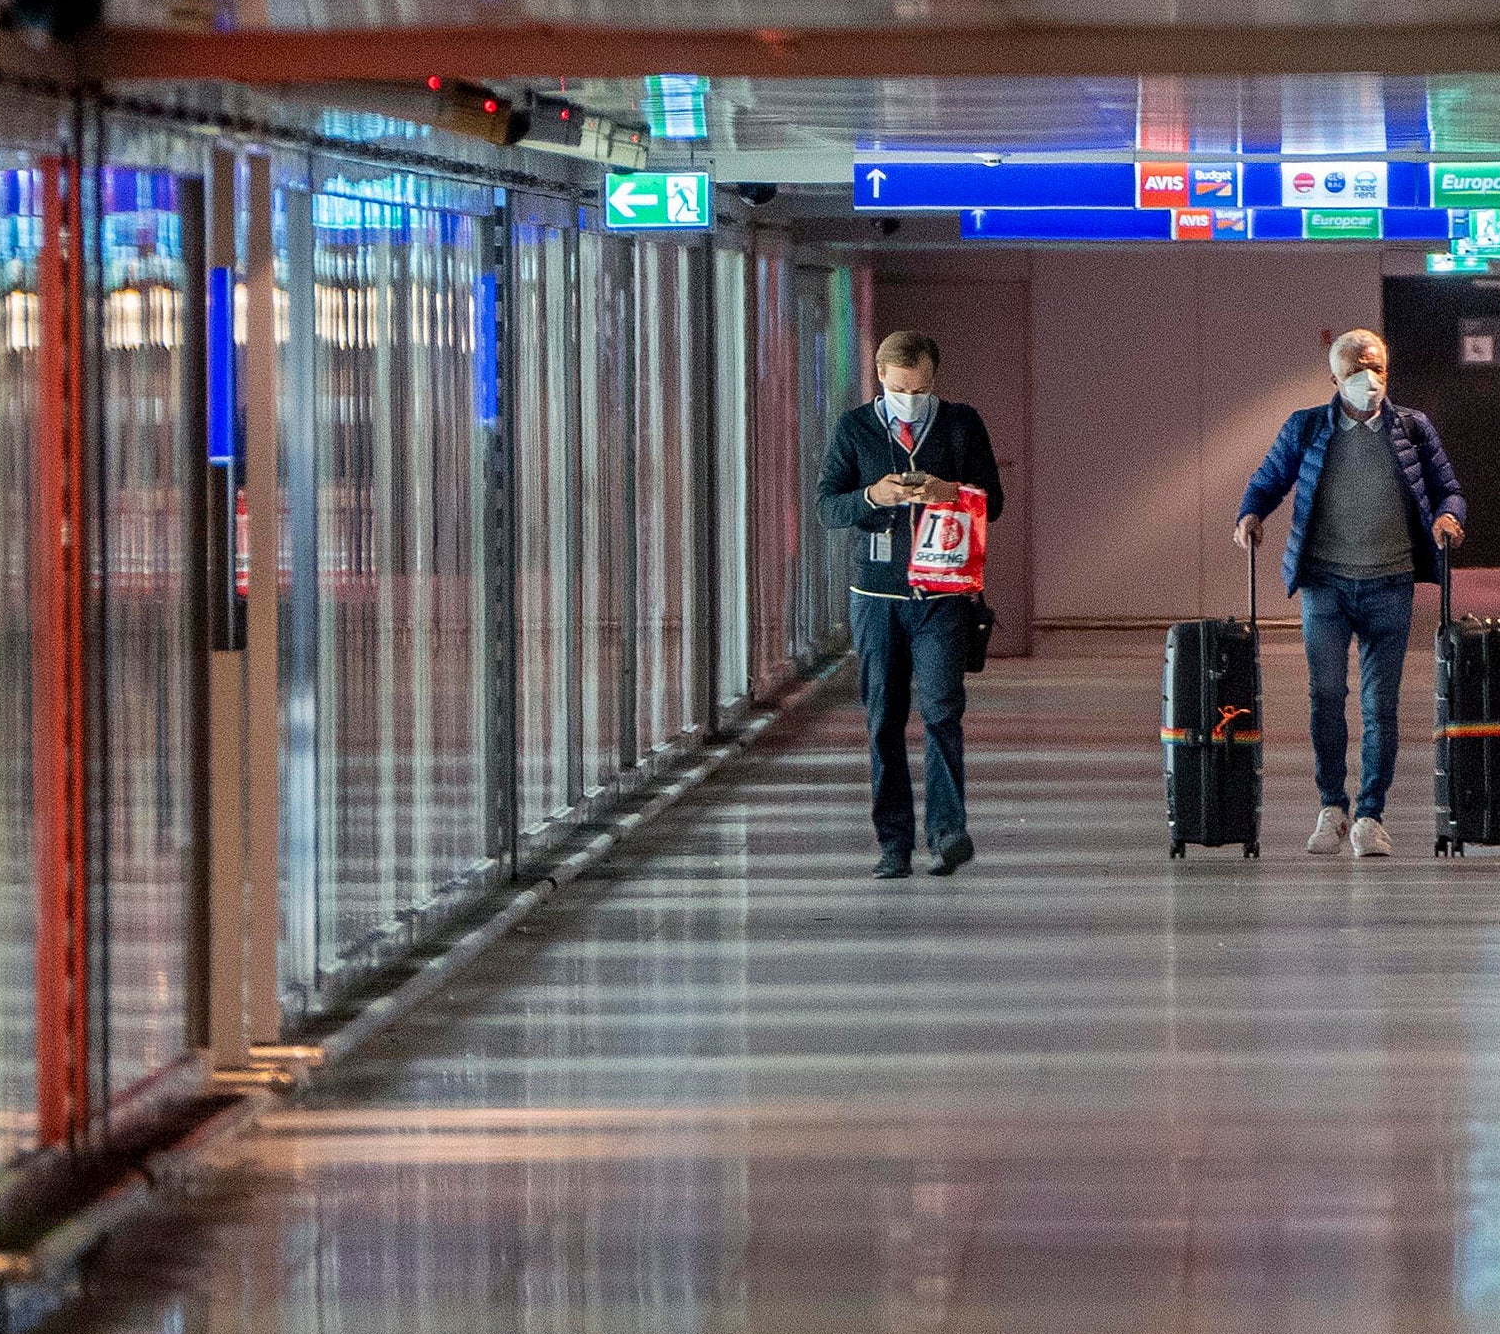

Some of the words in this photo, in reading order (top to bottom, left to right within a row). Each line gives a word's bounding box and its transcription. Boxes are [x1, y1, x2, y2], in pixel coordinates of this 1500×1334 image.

[1195, 170, 1232, 181] Budget
[1144, 175, 1184, 192] AVIS
[1179, 215, 1210, 227] AVIS
[1312, 214, 1374, 229] Europcar
